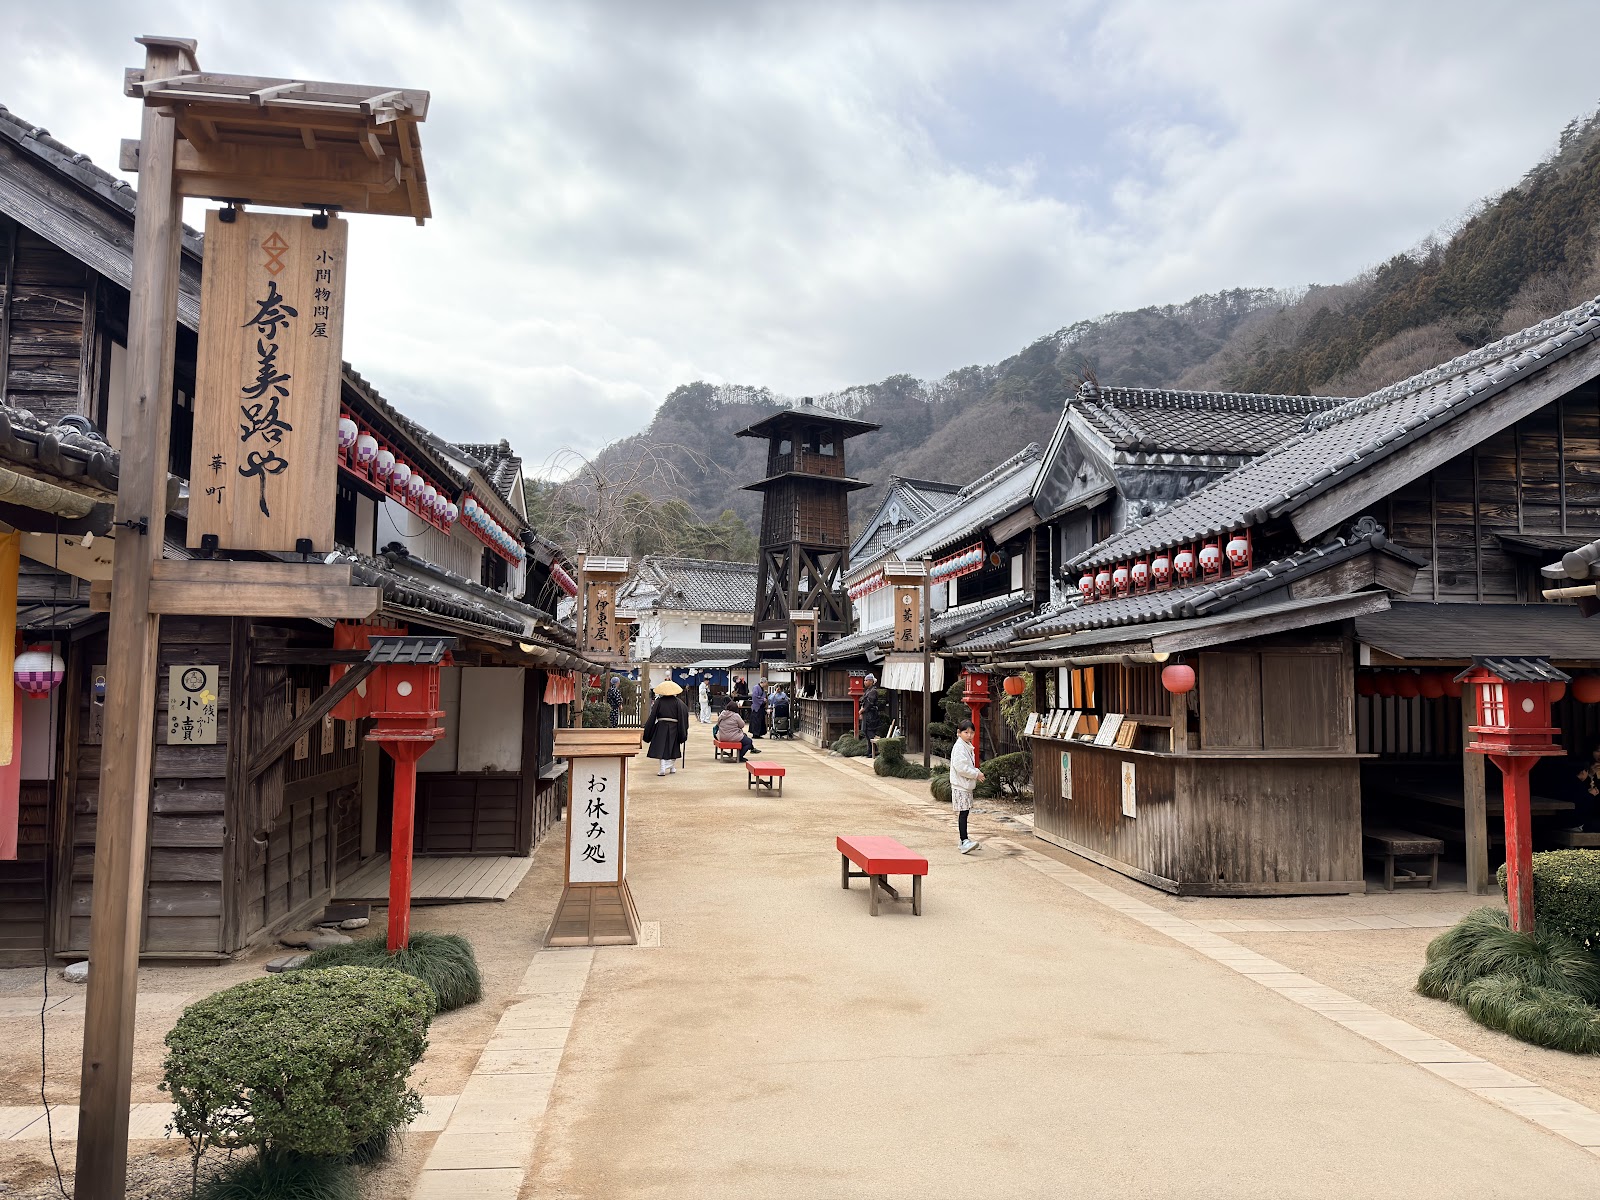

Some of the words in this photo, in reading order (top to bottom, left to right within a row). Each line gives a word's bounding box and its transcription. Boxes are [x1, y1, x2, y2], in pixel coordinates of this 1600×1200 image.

[239, 281, 298, 518] 奈美路や
[205, 453, 227, 505] 華町
[594, 599, 609, 642] 伊東屋
[901, 607, 914, 642] 菱屋
[582, 773, 609, 864] お休み処
